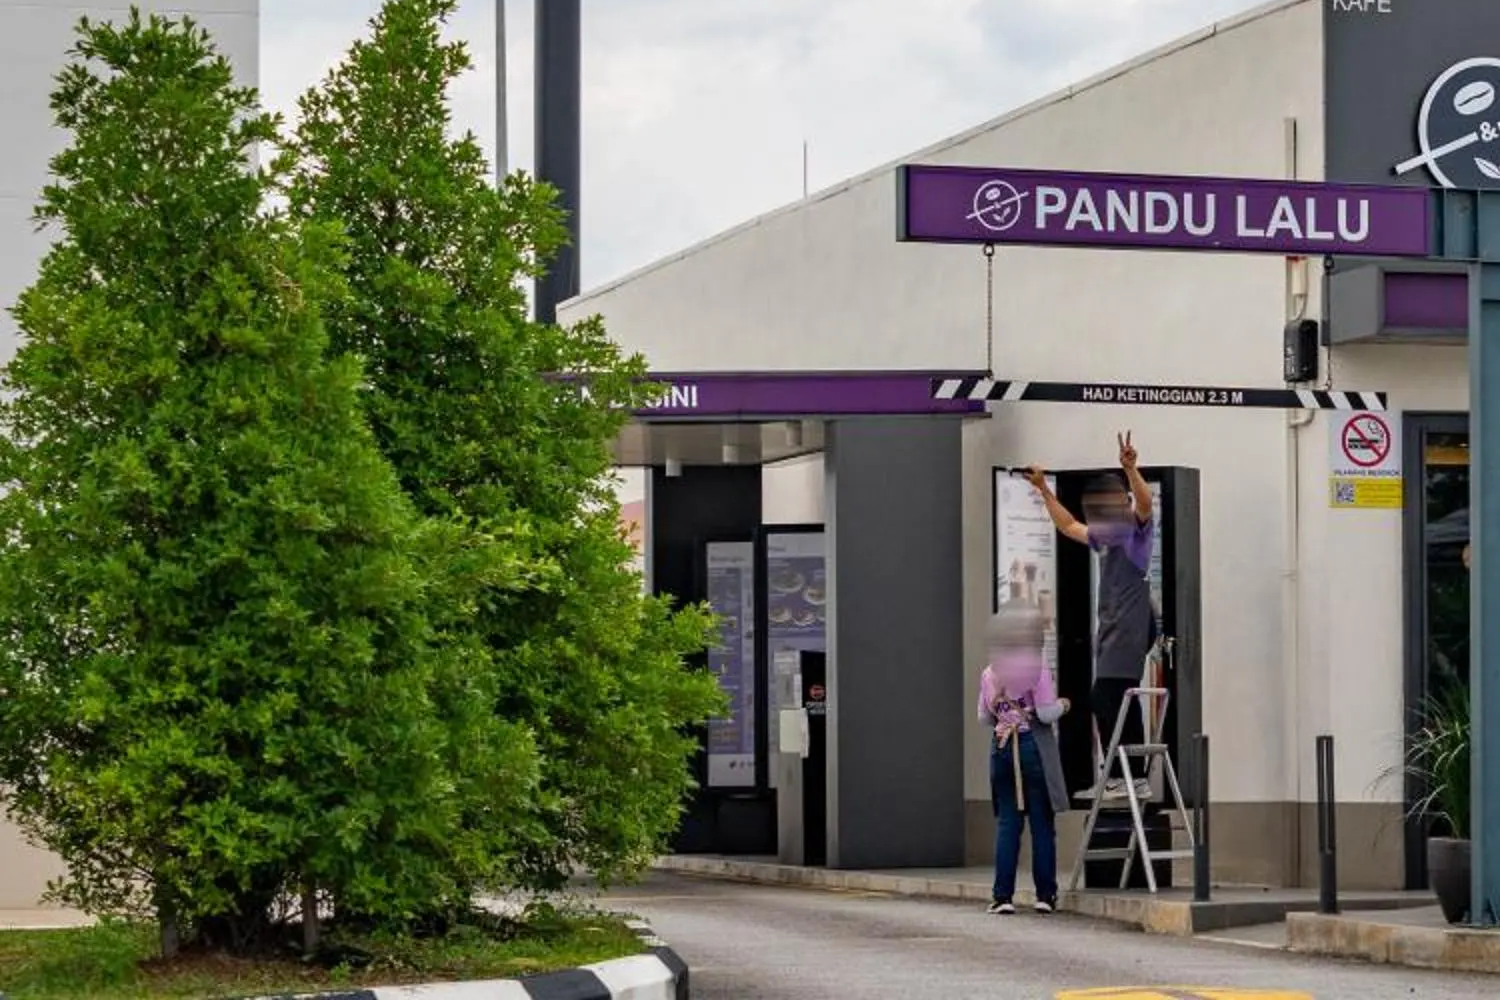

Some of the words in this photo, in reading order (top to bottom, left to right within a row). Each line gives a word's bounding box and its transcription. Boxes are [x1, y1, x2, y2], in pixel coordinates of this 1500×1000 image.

[1480, 121, 1500, 142] &
[1035, 186, 1215, 236] PANDU
[1236, 195, 1369, 242] LALU
[1083, 387, 1113, 400] HAD
[1117, 388, 1205, 403] KETINGGIAN
[1208, 391, 1228, 404] 2.3
[1231, 391, 1243, 404] M
